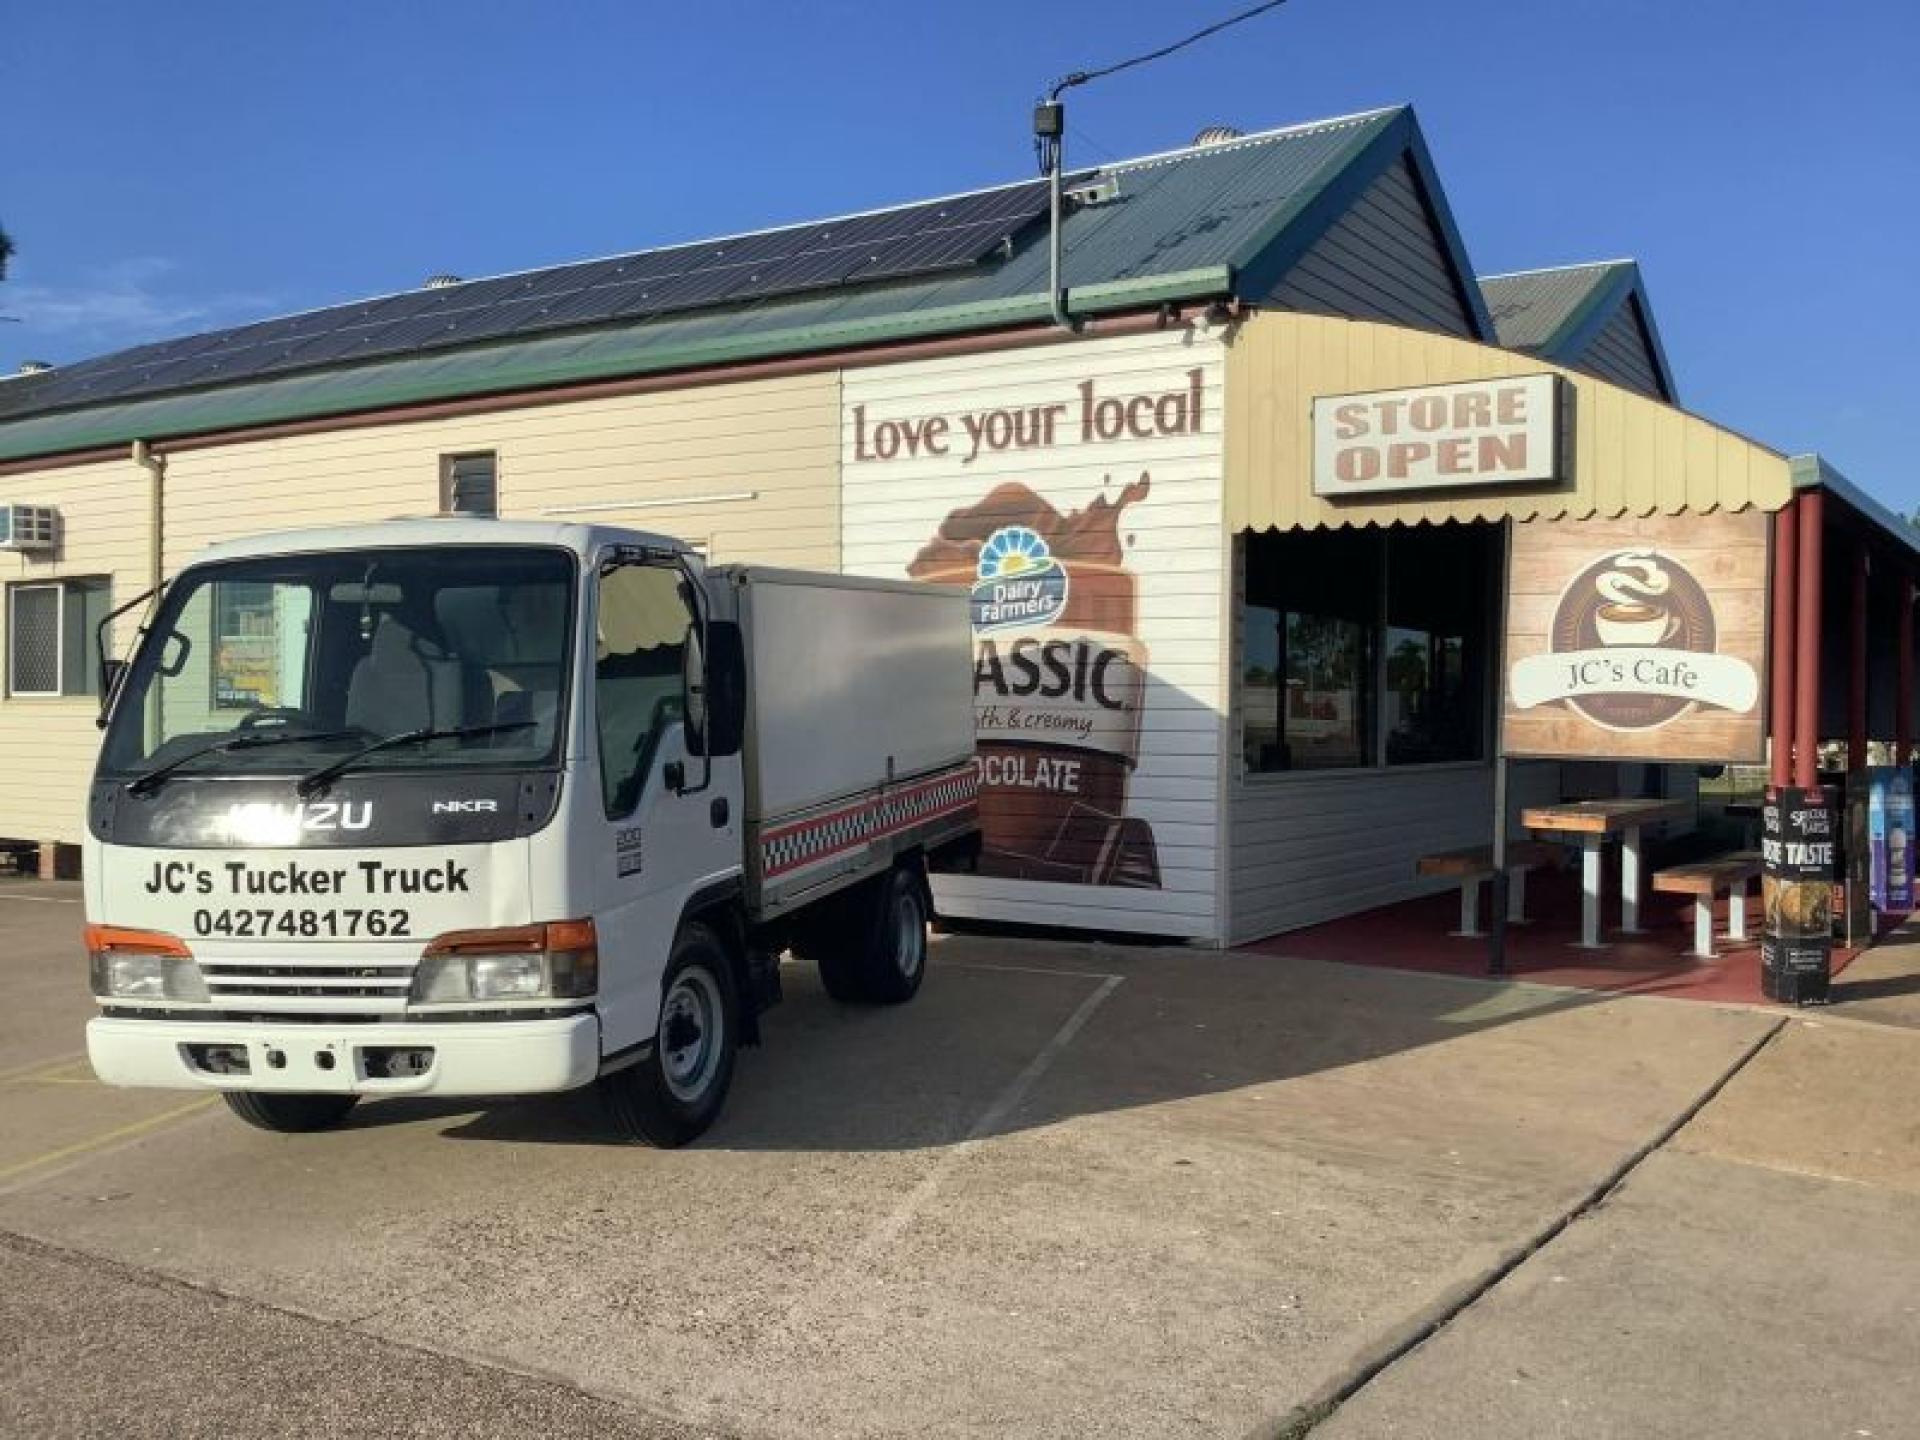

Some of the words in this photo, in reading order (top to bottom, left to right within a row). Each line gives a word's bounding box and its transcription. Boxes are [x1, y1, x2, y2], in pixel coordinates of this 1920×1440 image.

[853, 404, 949, 461] Love
[960, 404, 1066, 463] your
[1078, 368, 1203, 442] local
[1335, 386, 1528, 440] STORE
[1335, 432, 1528, 482] OPEN
[994, 580, 1042, 603] Dairy
[981, 595, 1055, 622] Farmers
[974, 637, 1129, 710] ASSIC
[1568, 660, 1623, 689] JC's
[1634, 660, 1698, 689] Cafe
[1007, 708, 1021, 730] &
[1025, 712, 1093, 740] creamy
[432, 800, 498, 812] NKR
[1785, 842, 1832, 865] TASTE
[145, 861, 213, 894] JC's
[225, 861, 346, 894] Tucker
[358, 859, 469, 894] Truck
[194, 909, 411, 937] 0427481762
